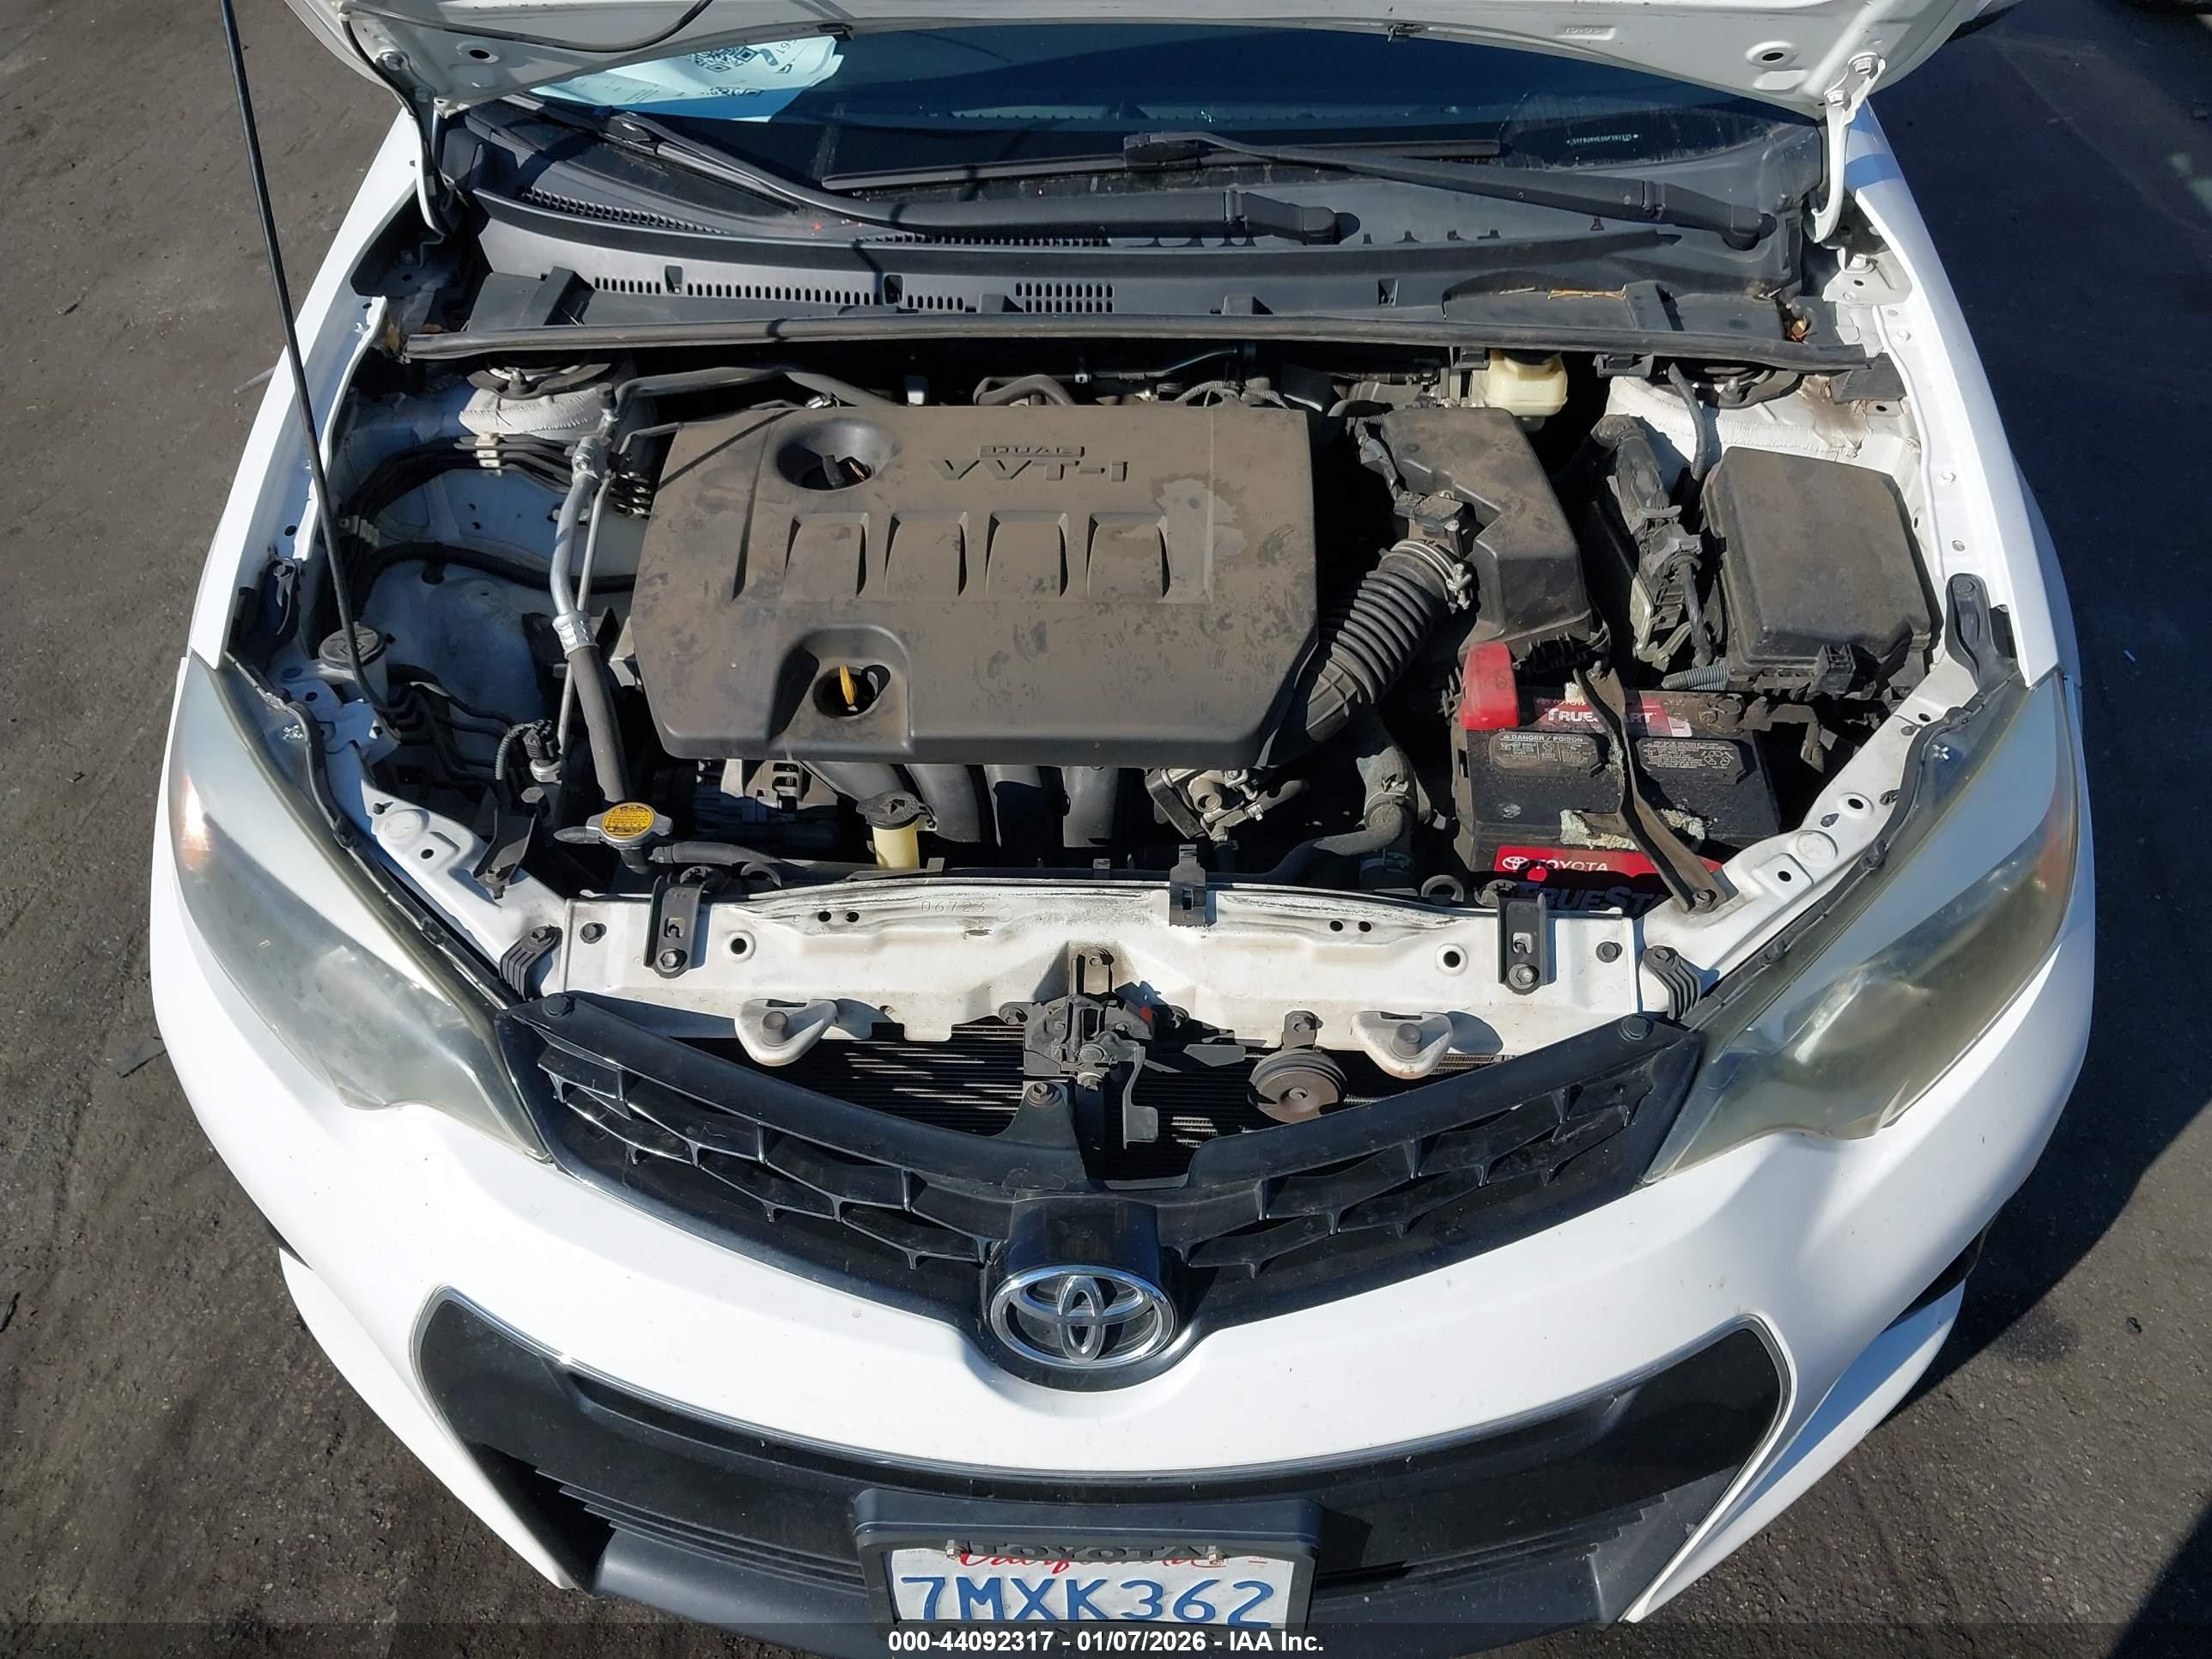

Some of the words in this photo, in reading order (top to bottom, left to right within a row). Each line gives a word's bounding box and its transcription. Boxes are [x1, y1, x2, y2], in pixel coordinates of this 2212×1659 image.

[991, 445, 1074, 456] DUAL
[1534, 859, 1609, 872] TOYOTA
[968, 1542, 1208, 1560] TOYOTA
[900, 1575, 1274, 1629] 7MXK362
